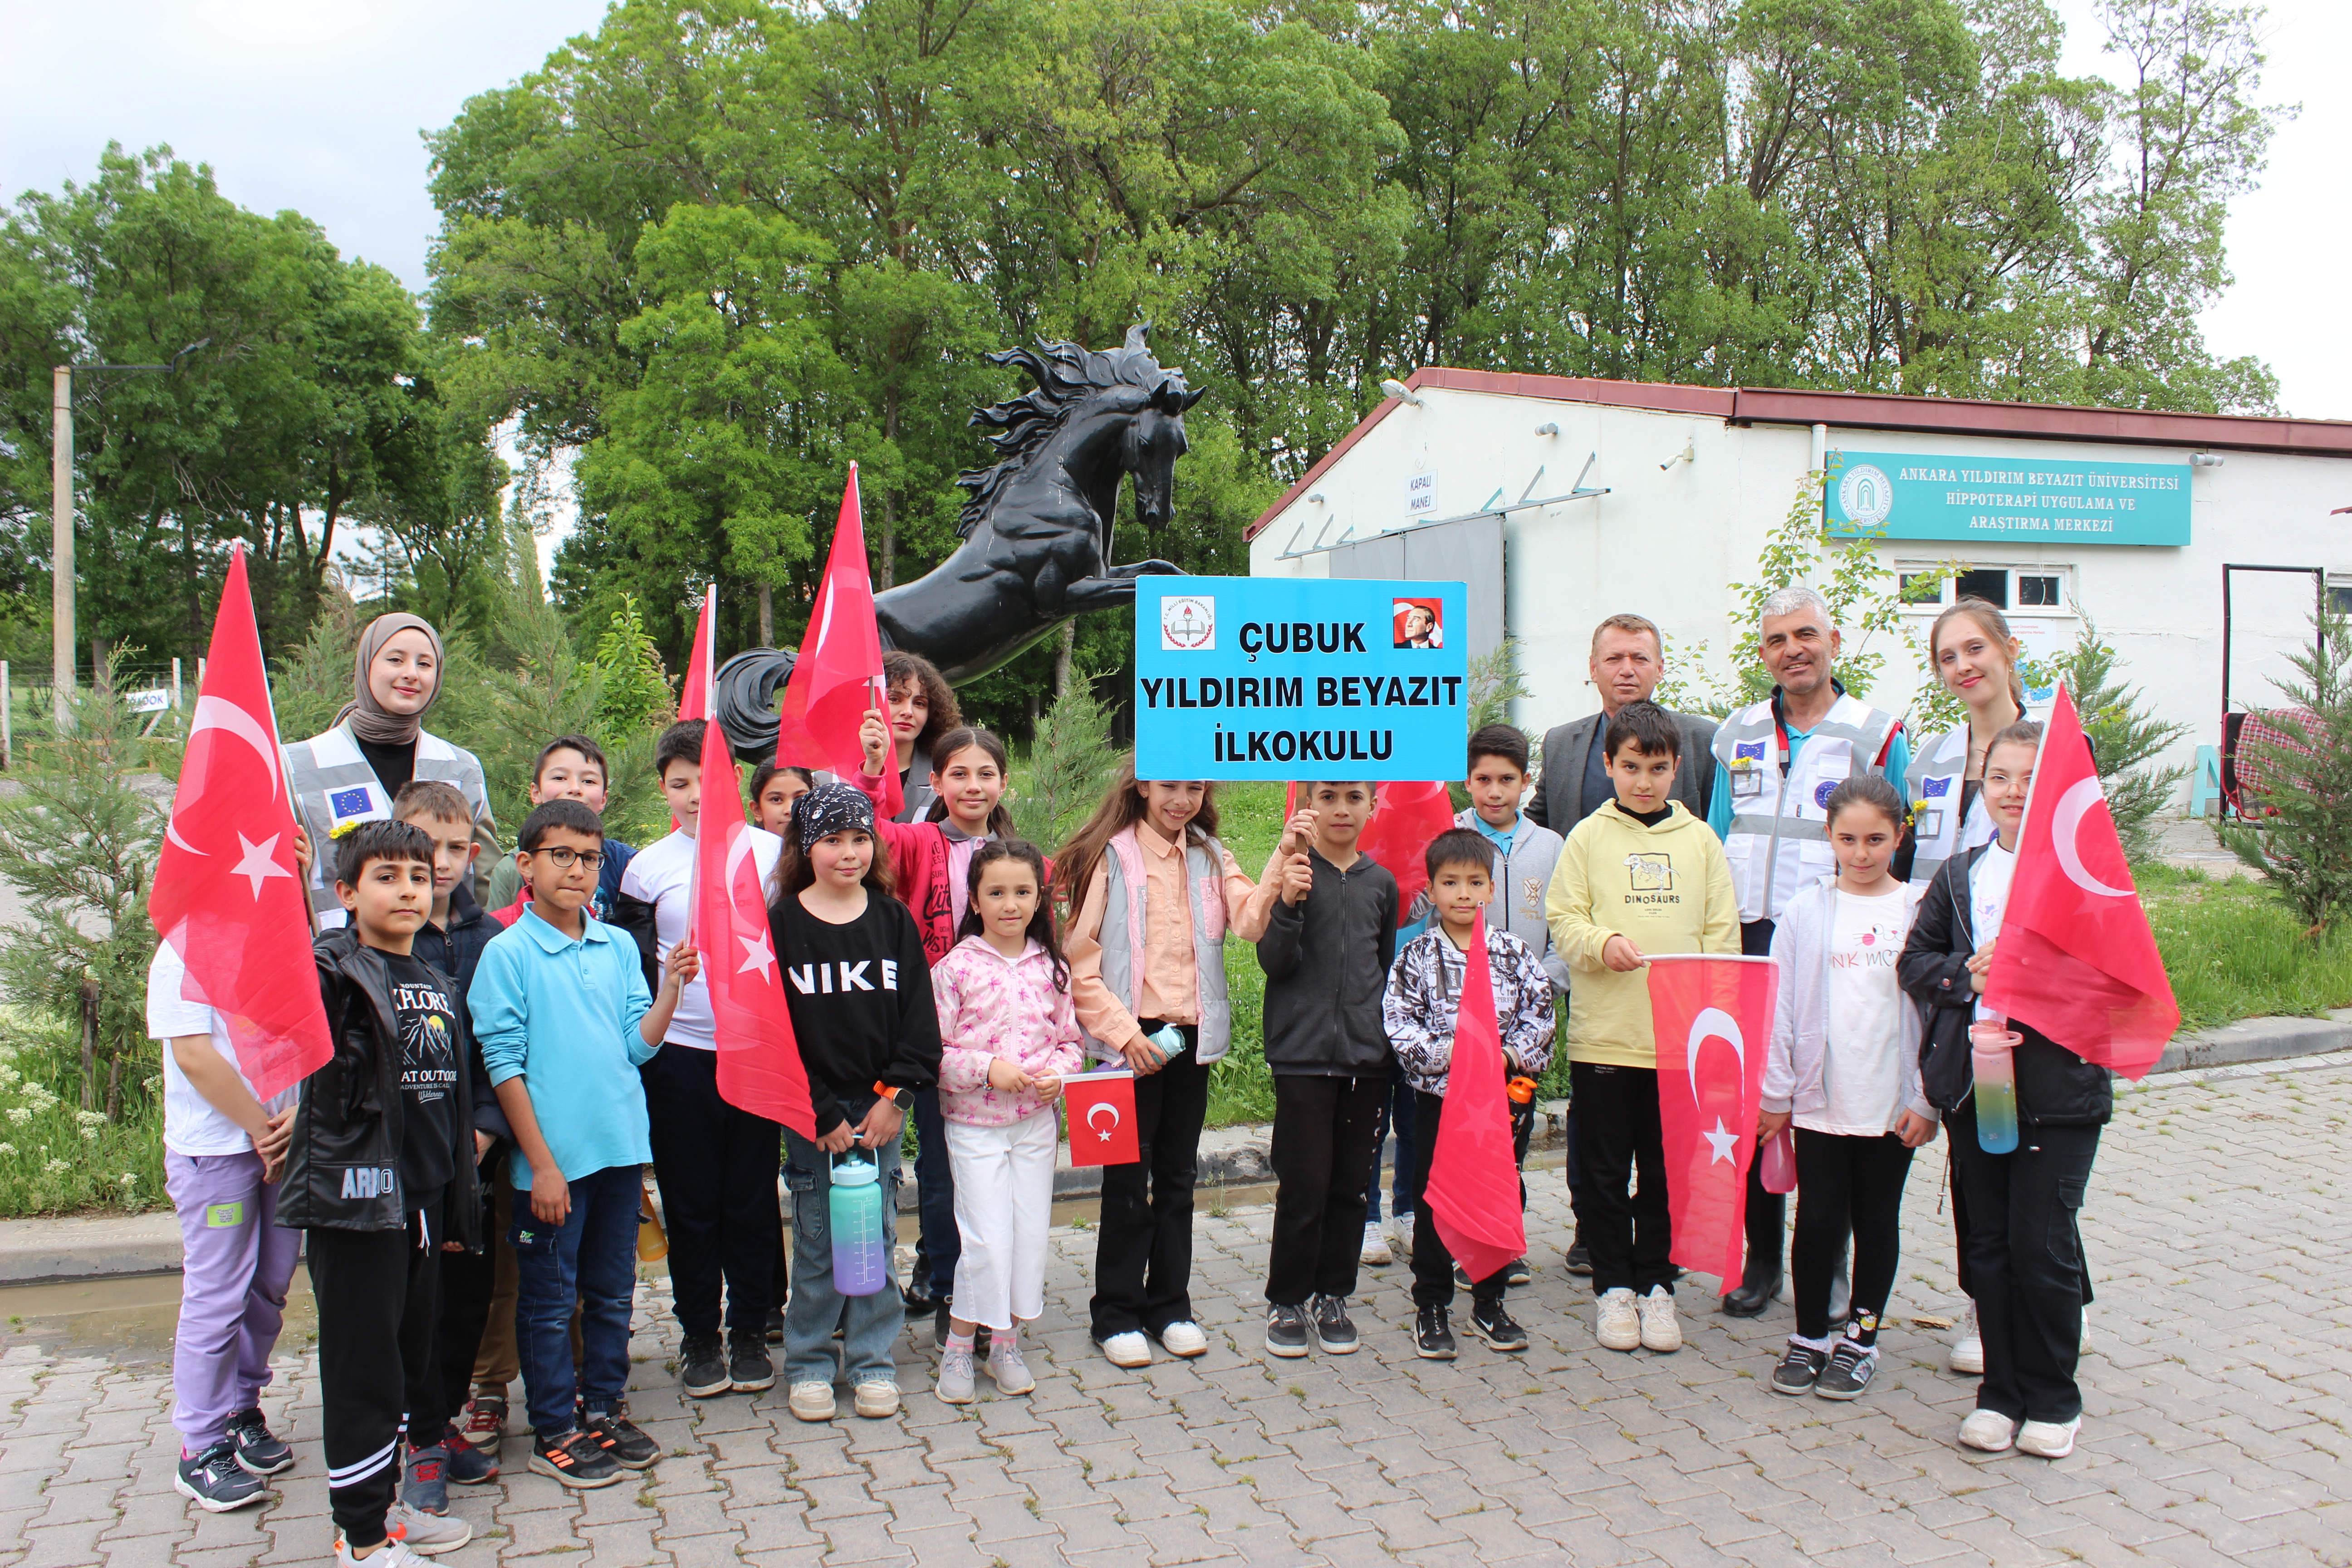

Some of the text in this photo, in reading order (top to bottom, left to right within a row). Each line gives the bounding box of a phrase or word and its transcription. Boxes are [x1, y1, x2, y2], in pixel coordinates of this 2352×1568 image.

[1410, 475, 1431, 492] KAPALI
[1899, 468, 2179, 491] ANKARA YILDIRIM BEYAZIT ÜNİVERSİTESİ
[1410, 495, 1431, 511] MANEJ
[1946, 489, 2136, 511] HİPPOTERAPİ UYGULAMA VE
[1970, 516, 2113, 533] ARAŞTIRMA MERKEZİ
[1240, 623, 1365, 662] ÇUBUK
[1141, 677, 1461, 707] YILDIRIM BEYAZIT
[1215, 723, 1391, 761] İLKOKULU
[1625, 895, 1680, 904] DINOSAURS
[788, 959, 897, 994] NIKE
